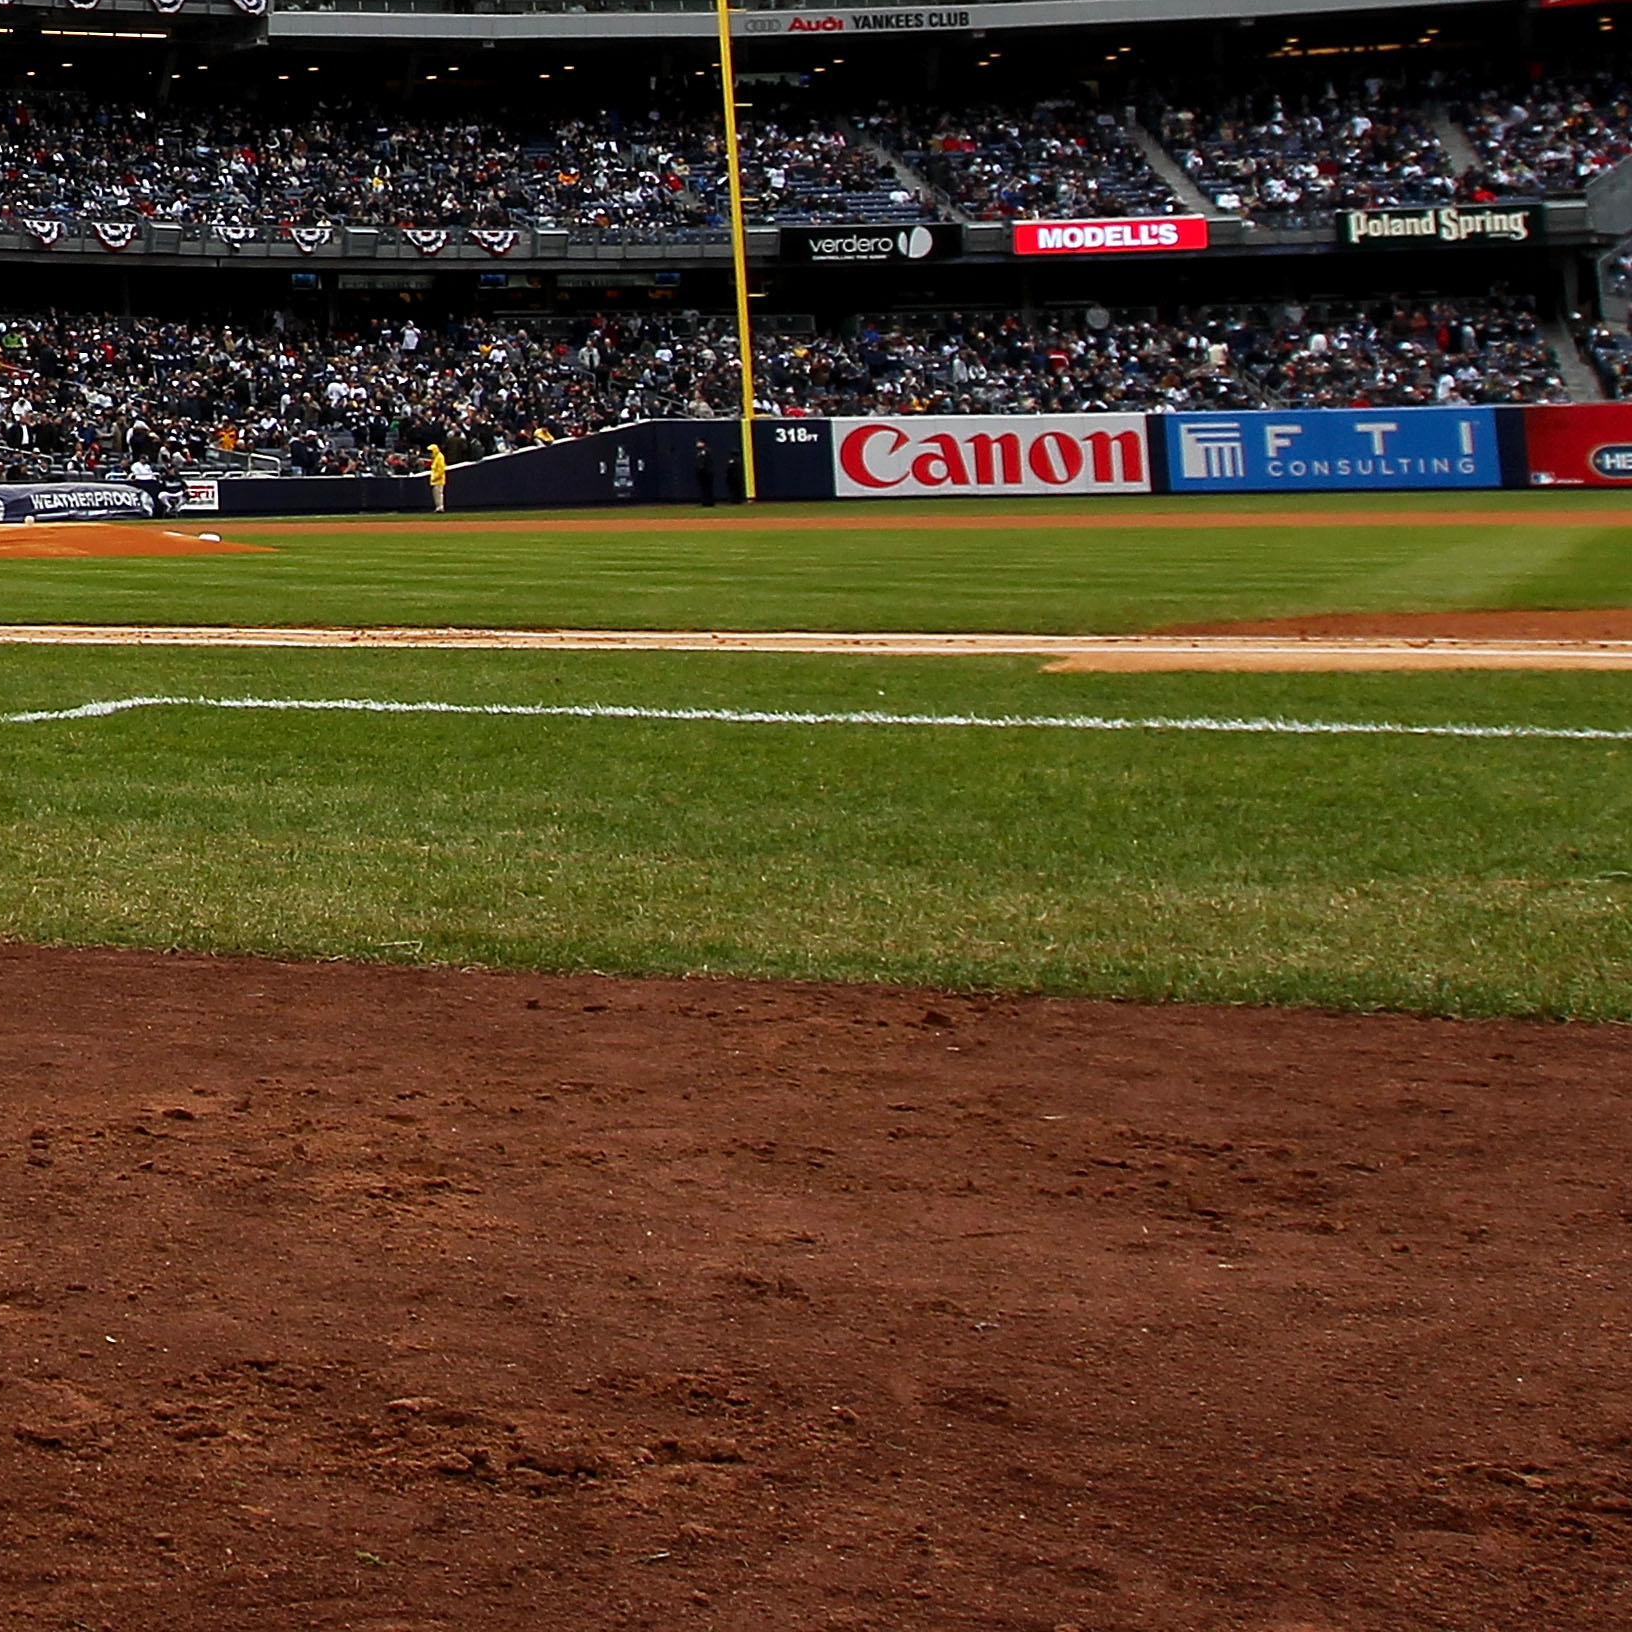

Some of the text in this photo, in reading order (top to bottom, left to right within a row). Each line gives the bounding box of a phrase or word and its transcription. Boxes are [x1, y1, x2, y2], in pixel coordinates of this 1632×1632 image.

[788, 11, 970, 32] Audi YANKEES CLUB
[1037, 223, 1179, 249] MODELL'S
[1349, 207, 1530, 244] Poland Spring
[808, 234, 894, 253] verdero
[839, 423, 1145, 489] Canon
[1268, 457, 1475, 477] CONSULTING
